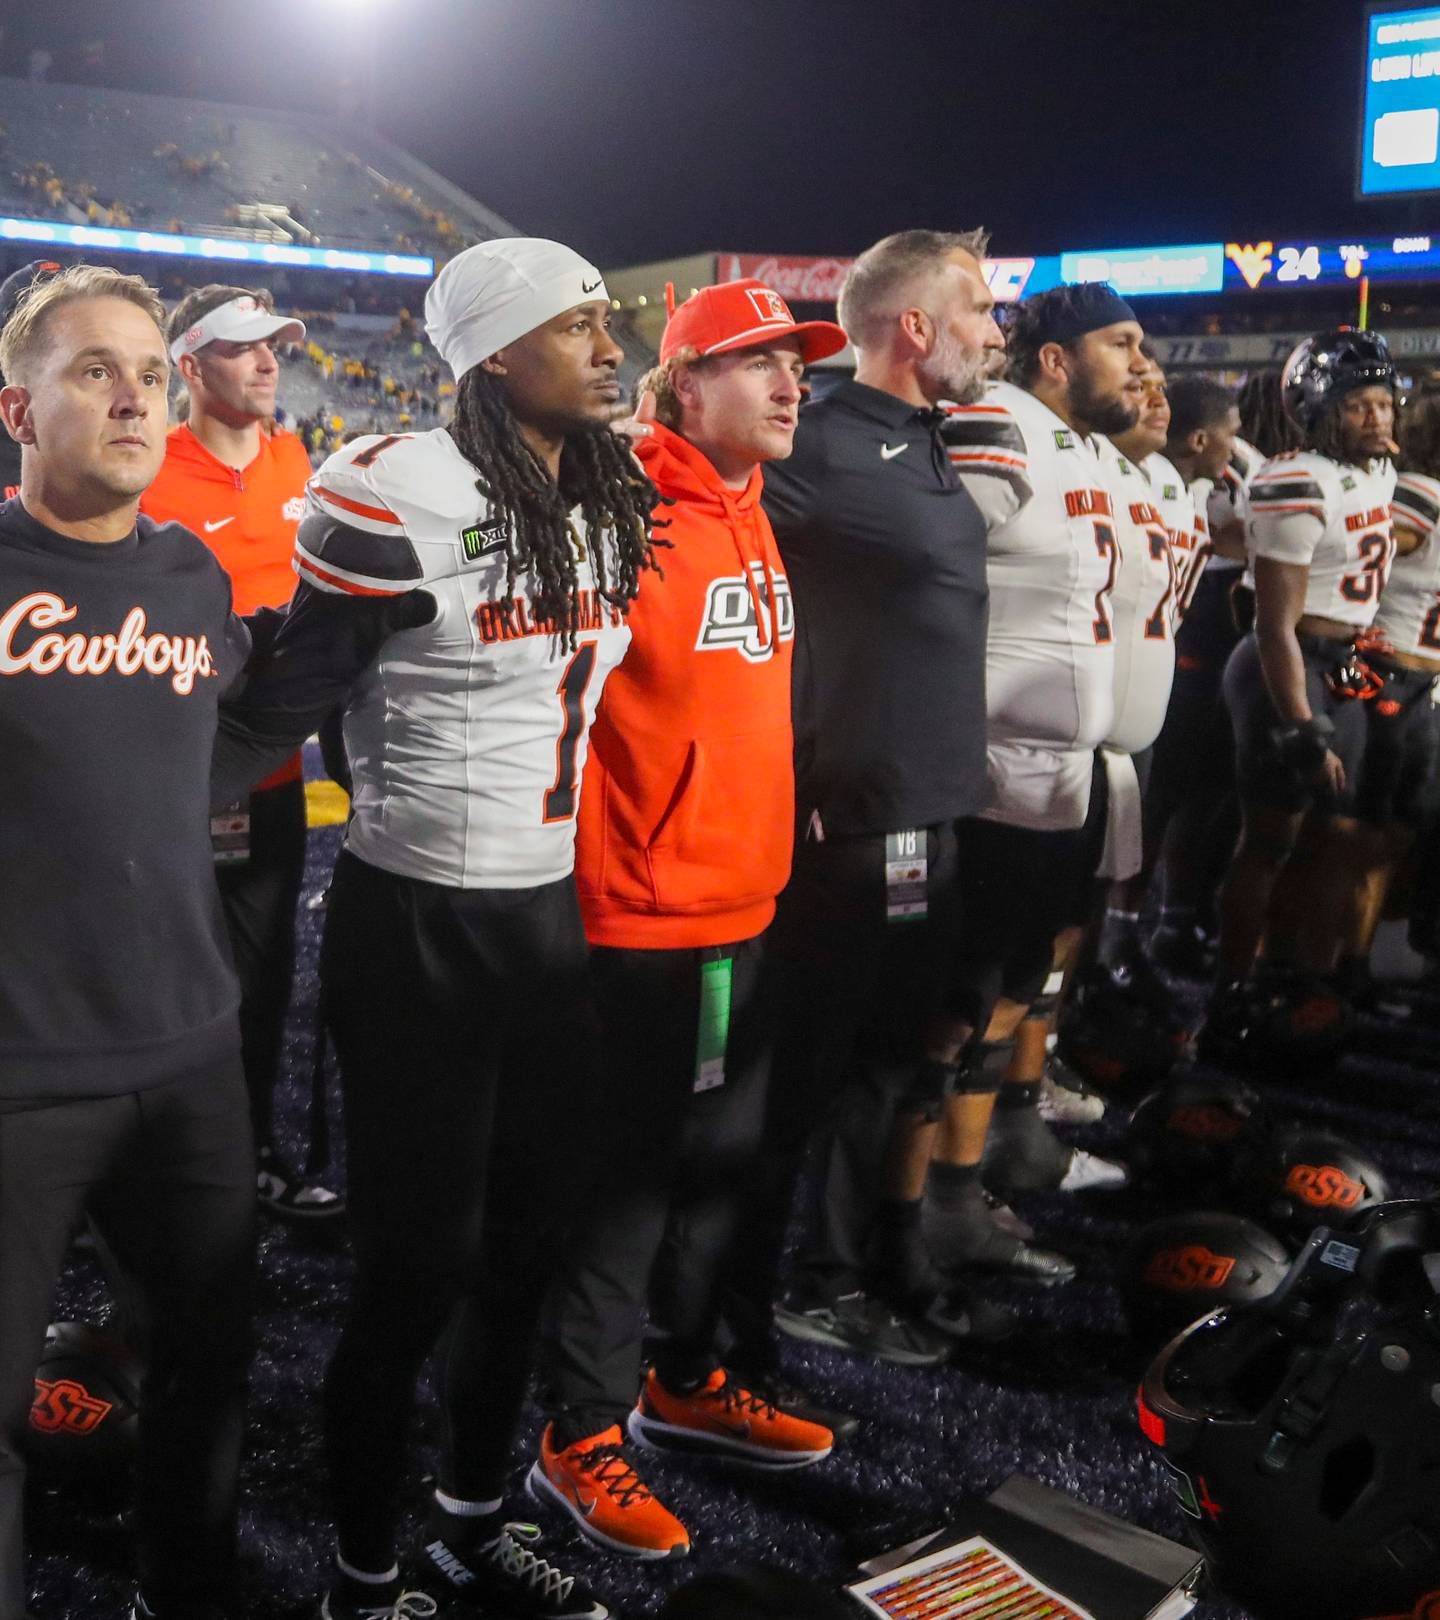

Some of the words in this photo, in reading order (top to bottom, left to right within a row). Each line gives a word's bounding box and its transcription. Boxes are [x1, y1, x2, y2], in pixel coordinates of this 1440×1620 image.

[1277, 247, 1321, 281] 24
[542, 640, 598, 824] 1
[1285, 1163, 1366, 1208] OSU
